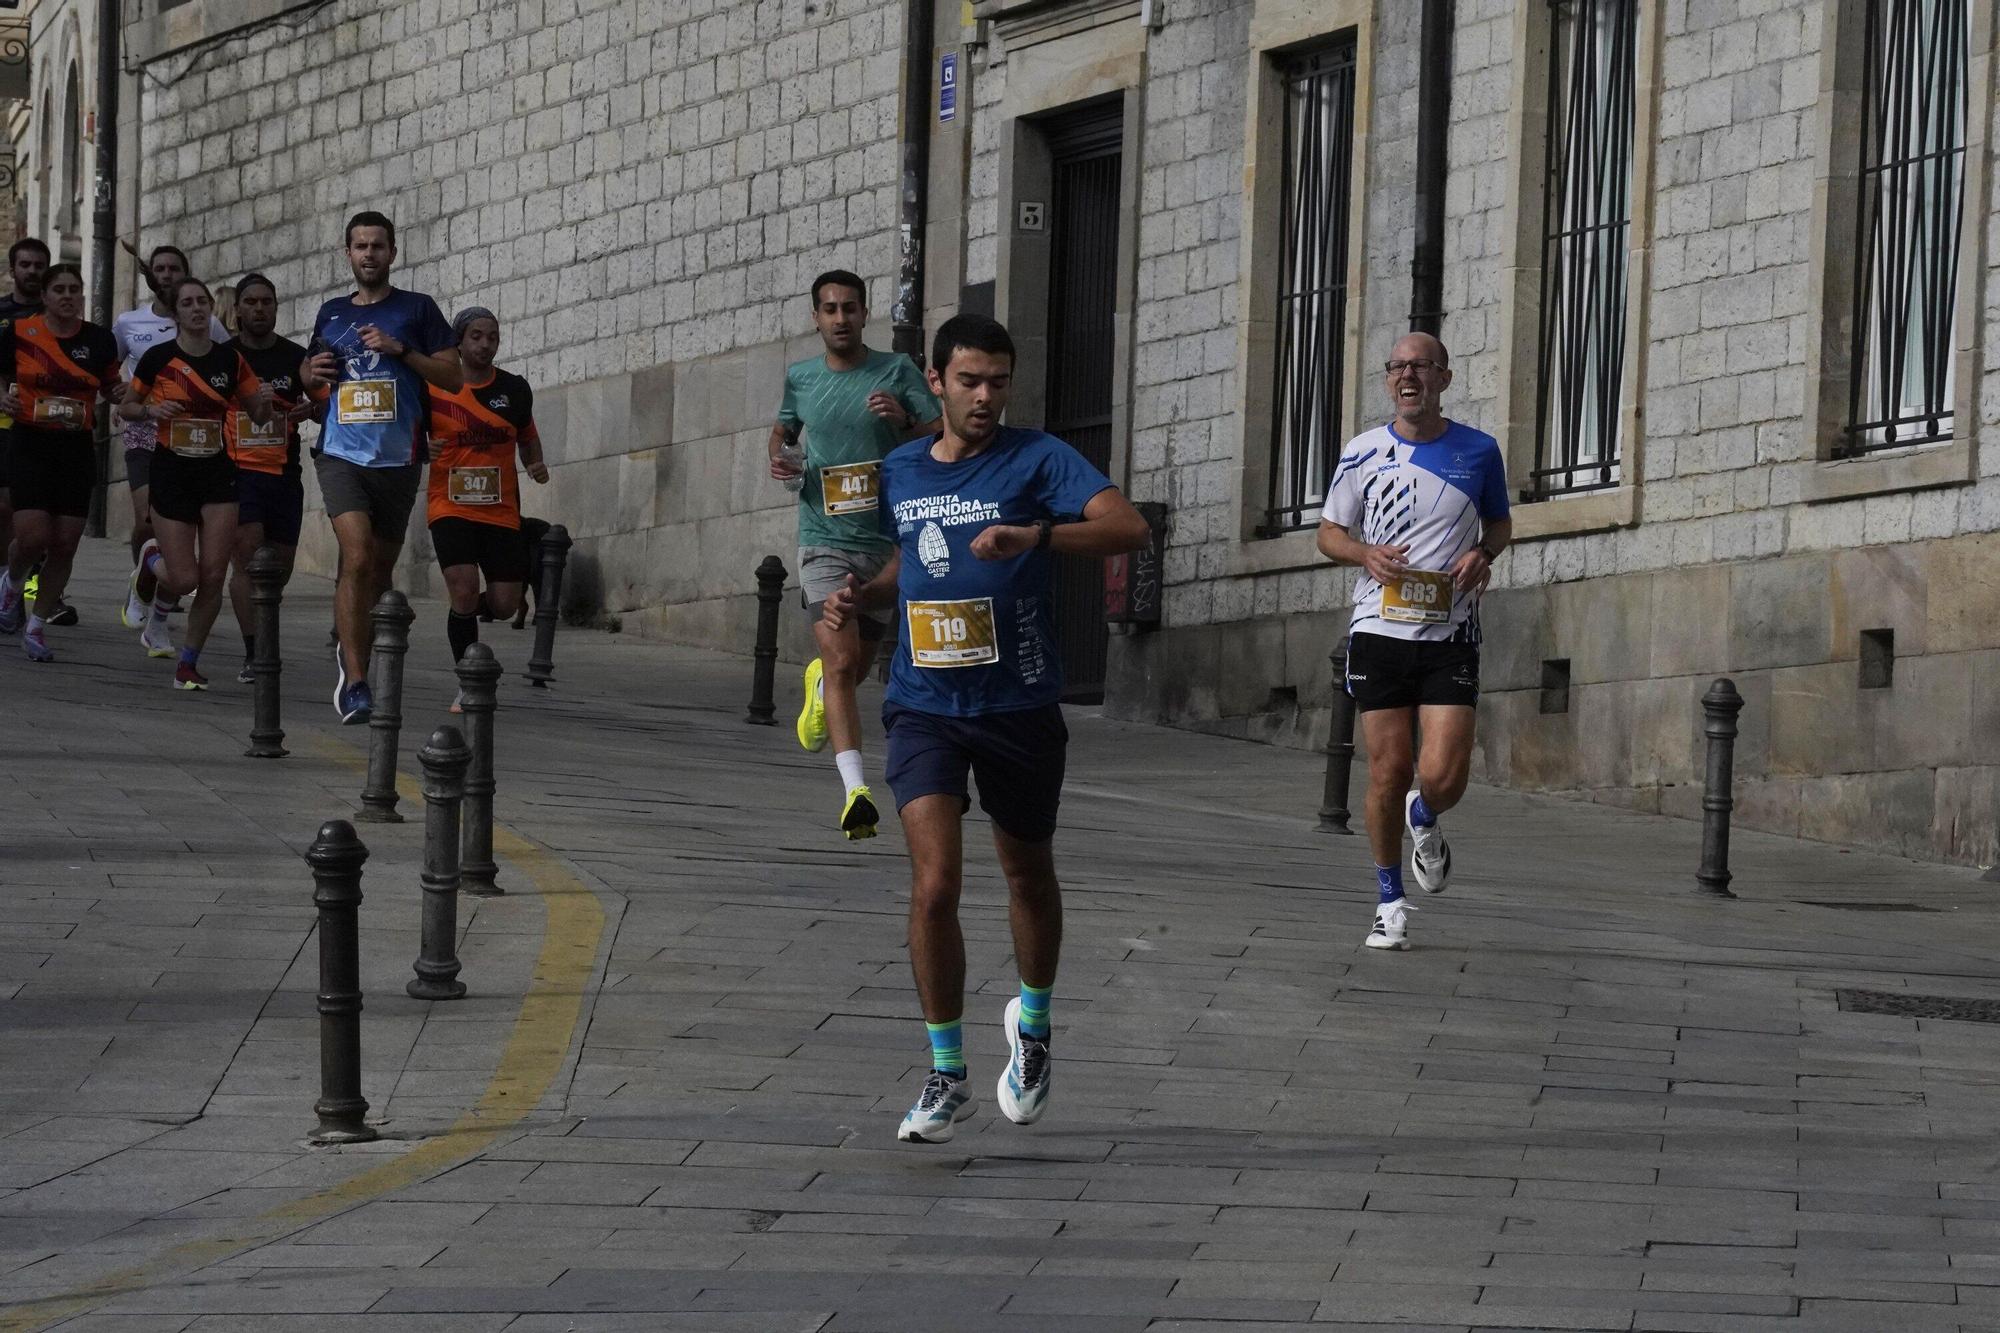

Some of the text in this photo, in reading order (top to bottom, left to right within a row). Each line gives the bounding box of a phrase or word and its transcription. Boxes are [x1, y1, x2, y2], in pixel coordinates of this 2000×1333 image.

[353, 390, 380, 407] 681
[190, 428, 207, 443] 45
[463, 475, 488, 491] 347
[841, 474, 869, 495] 447
[893, 503, 900, 514] LA
[900, 494, 960, 511] CONQUISTA
[900, 499, 983, 523] ALMENDRA
[982, 502, 999, 511] REN
[942, 509, 1001, 527] KONKISTA
[927, 561, 950, 569] VITORIA
[927, 566, 950, 574] GASTEIZ
[1400, 582, 1438, 604] 683
[930, 617, 967, 643] 119
